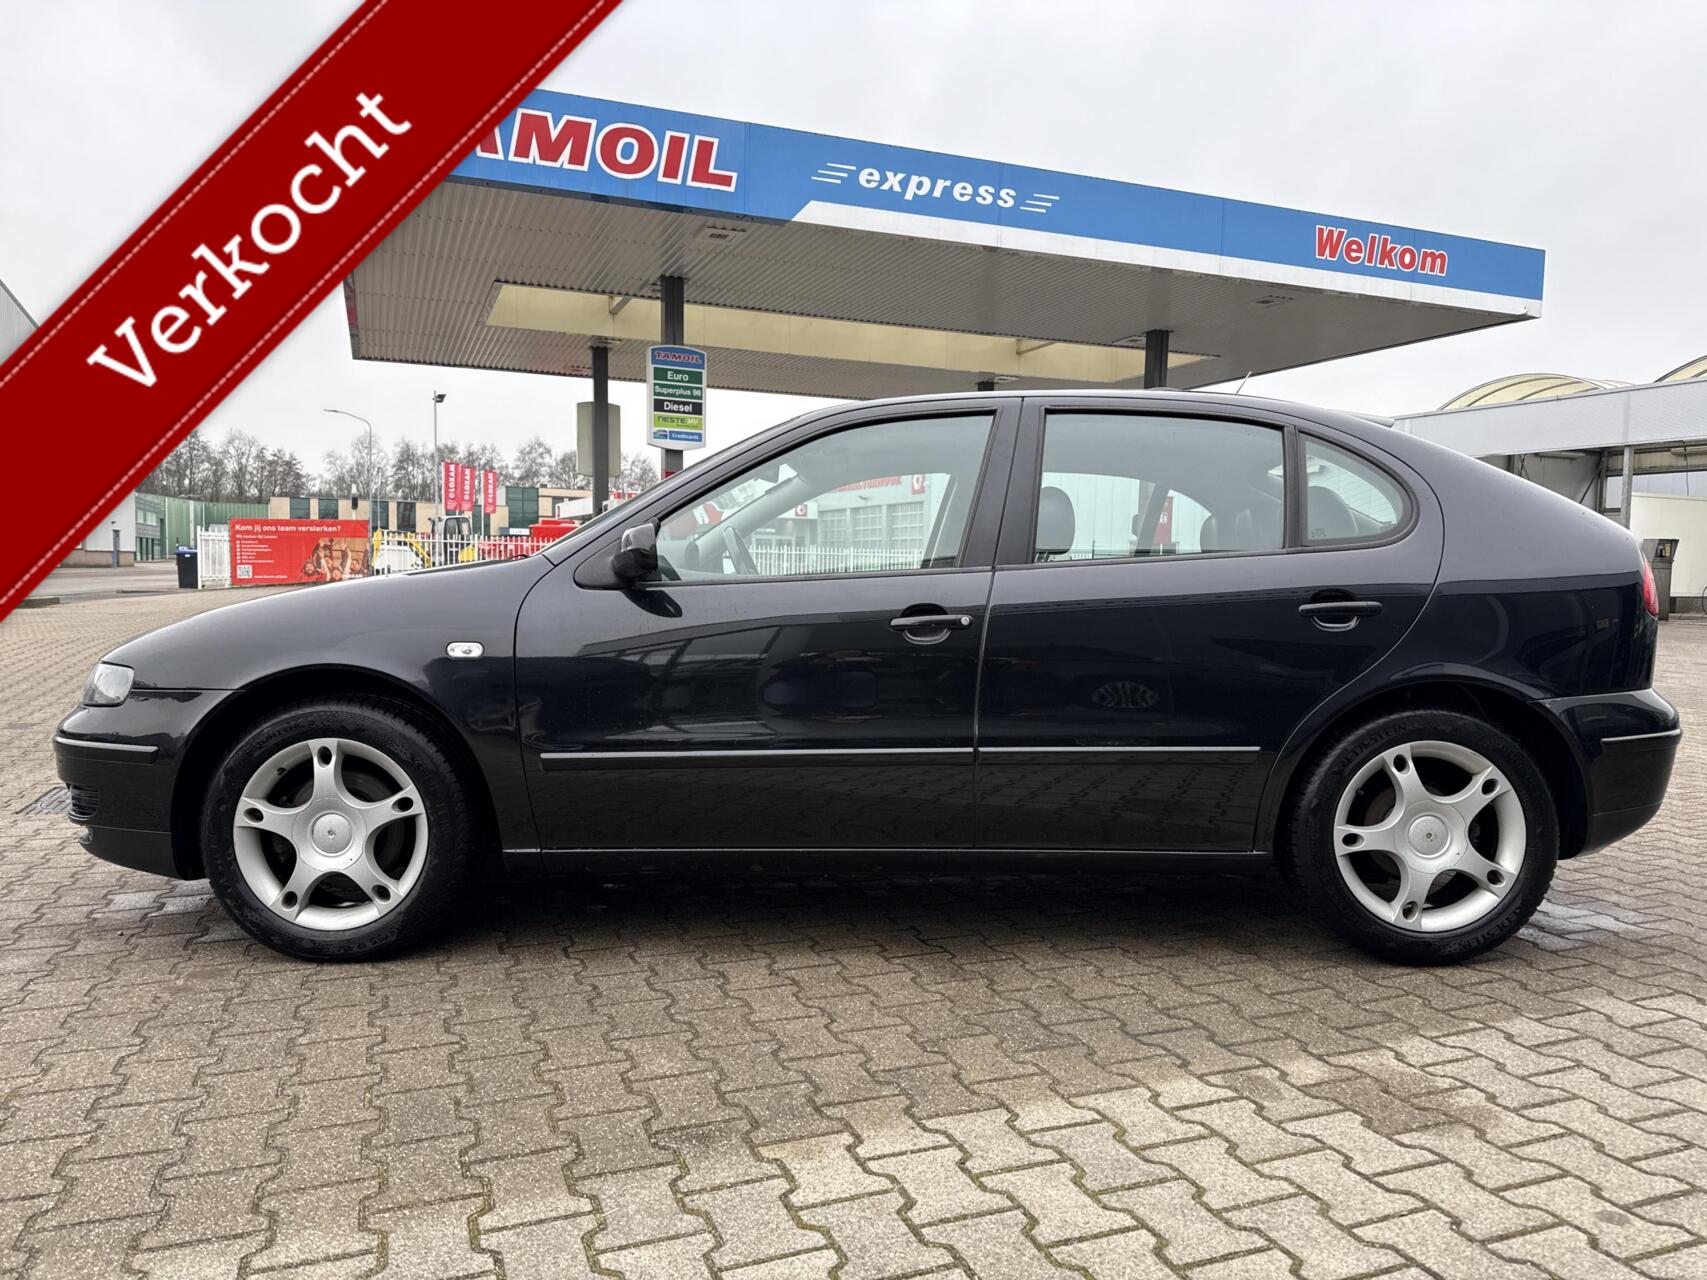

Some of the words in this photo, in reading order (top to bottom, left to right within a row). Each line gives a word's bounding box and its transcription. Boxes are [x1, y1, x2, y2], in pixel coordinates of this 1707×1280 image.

[858, 167, 1017, 208] express
[1316, 225, 1448, 276] Welkom
[655, 351, 702, 363] TAMOIL
[667, 371, 689, 381] Euro
[654, 385, 691, 396] Superplus
[692, 389, 702, 397] 98
[663, 401, 693, 412] Diesel
[254, 524, 262, 533] jij
